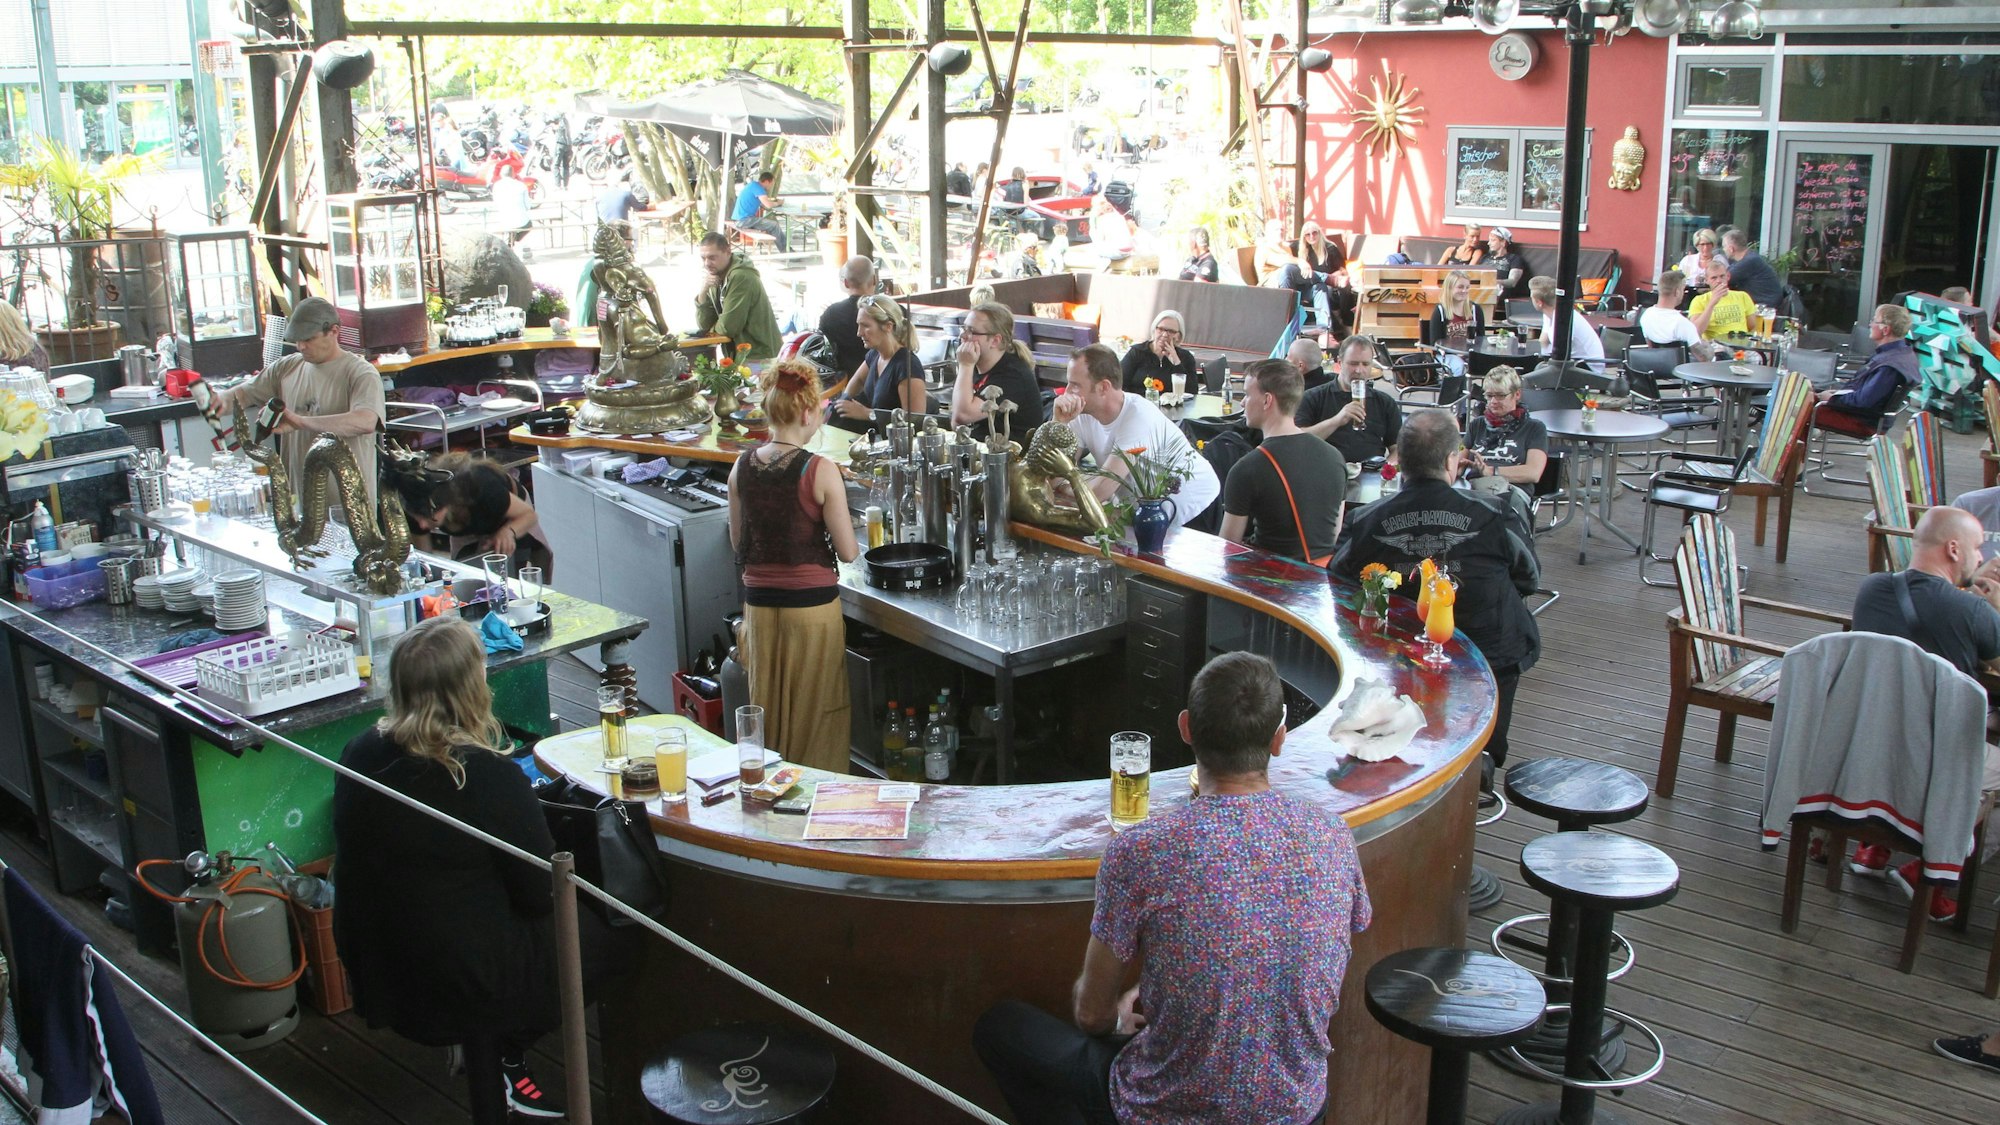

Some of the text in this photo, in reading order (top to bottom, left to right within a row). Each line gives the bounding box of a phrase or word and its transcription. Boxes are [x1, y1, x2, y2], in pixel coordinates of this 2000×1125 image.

[1844, 160, 1858, 171] du
[1854, 189, 1868, 198] es
[1381, 510, 1472, 535] HARLEY-DAVIDSON
